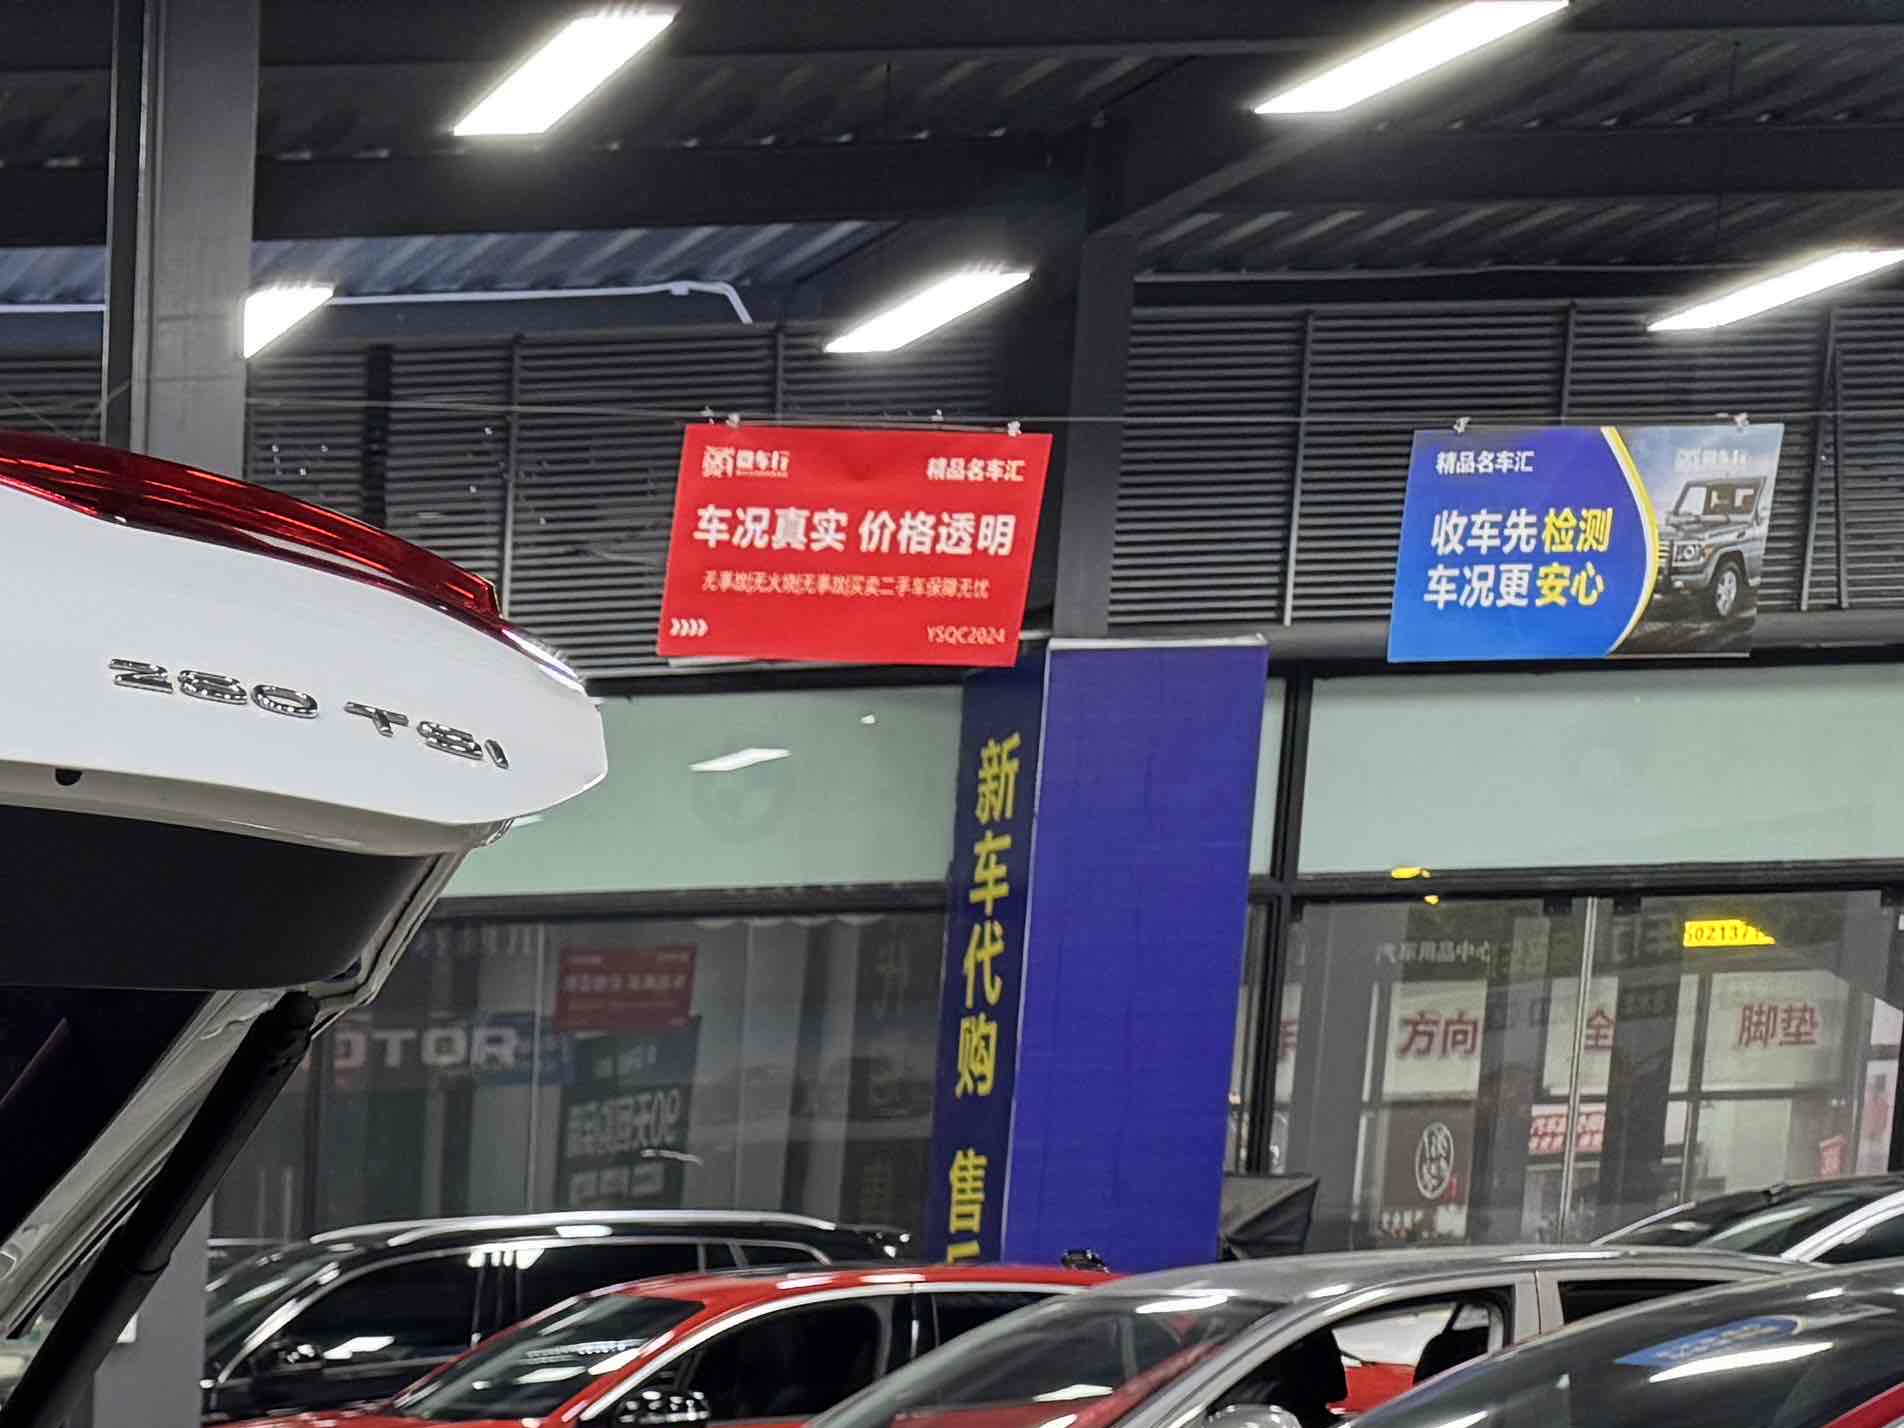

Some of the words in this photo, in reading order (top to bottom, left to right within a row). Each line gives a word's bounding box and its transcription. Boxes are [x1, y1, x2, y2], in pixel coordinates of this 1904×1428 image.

[927, 457, 1024, 482] 精品名车汇
[1436, 450, 1533, 474] 精品名车汇
[693, 505, 848, 552] 车况真实
[858, 512, 1017, 557] 价格透明
[1429, 506, 1614, 557] 收车先检测
[1423, 562, 1605, 610] 车况更安心
[107, 656, 320, 720] 280
[343, 700, 509, 771] TSI
[955, 733, 1020, 1097] 新车代购
[1398, 1008, 1480, 1058] 方向
[1735, 1002, 1820, 1048] 脚垫
